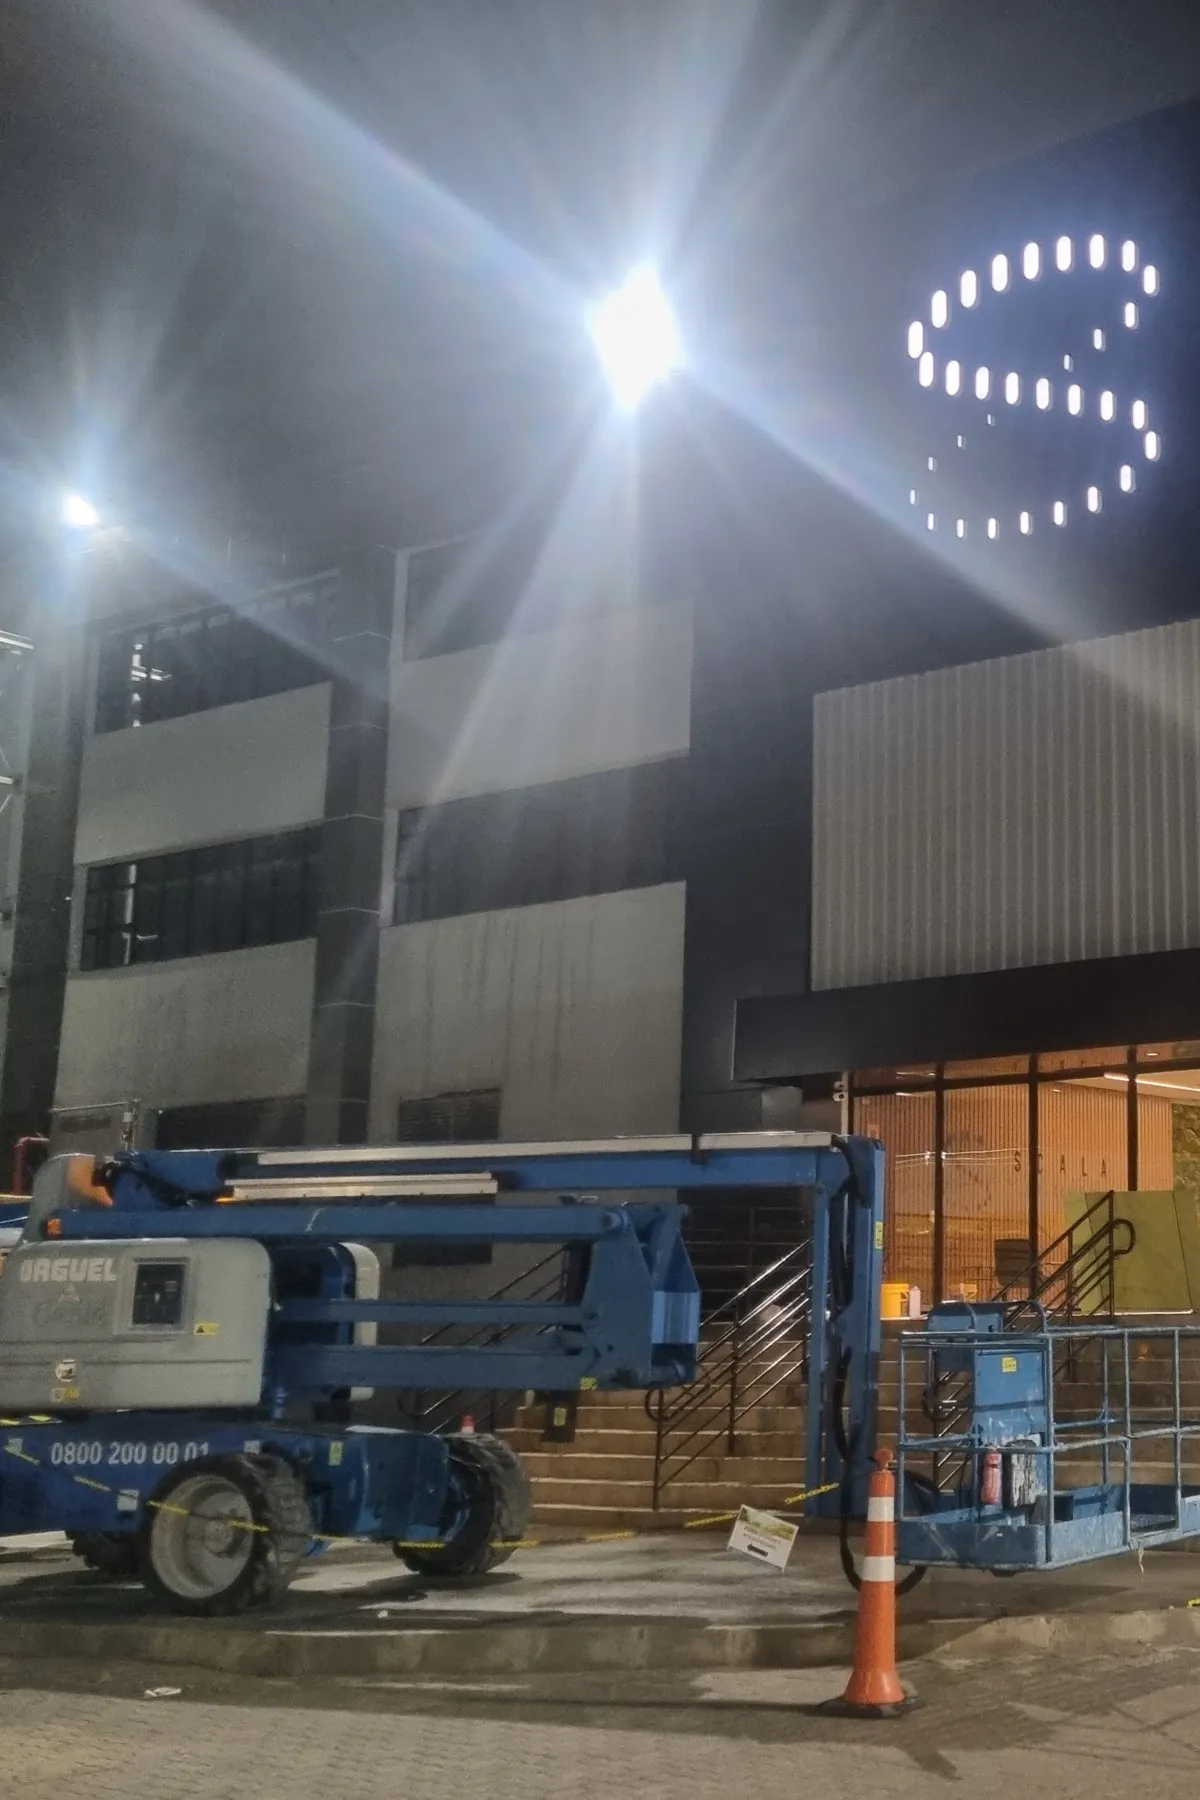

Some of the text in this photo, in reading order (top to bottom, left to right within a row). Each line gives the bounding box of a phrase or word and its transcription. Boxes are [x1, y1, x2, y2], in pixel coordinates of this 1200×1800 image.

[51, 1441, 103, 1465] 0800
[108, 1441, 147, 1465] 200
[152, 1441, 179, 1465] 00
